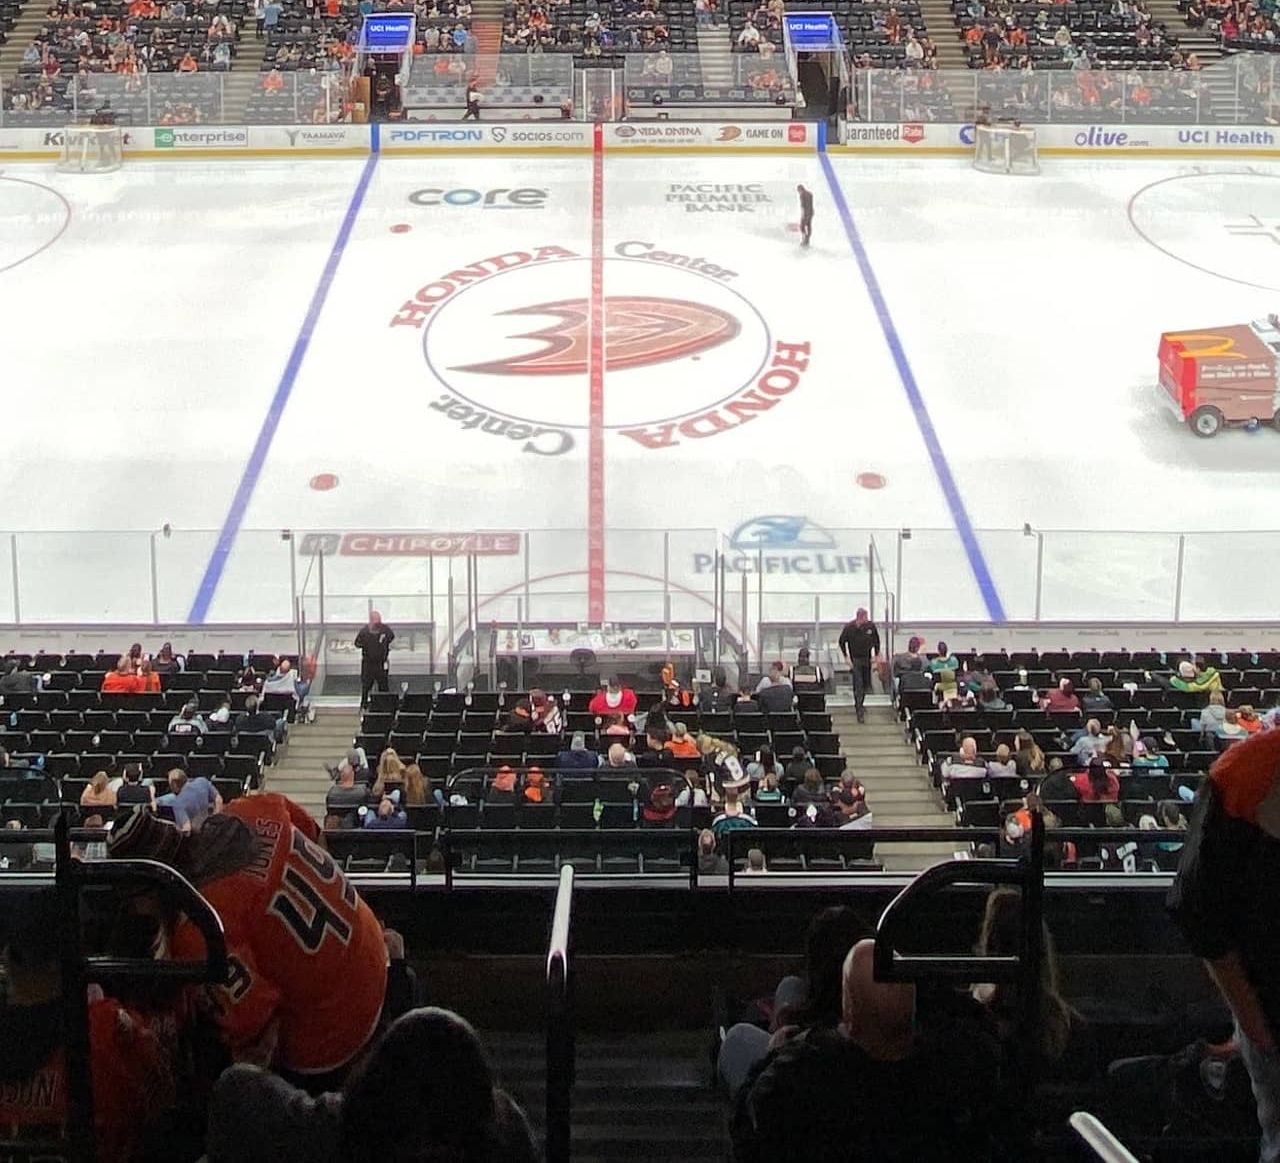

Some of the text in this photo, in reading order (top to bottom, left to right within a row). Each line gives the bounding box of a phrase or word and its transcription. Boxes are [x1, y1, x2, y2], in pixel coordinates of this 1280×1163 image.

[161, 132, 245, 144] enterprise
[390, 130, 482, 141] PDFTRON
[512, 132, 583, 141] socios.com
[746, 128, 769, 138] GAME
[771, 128, 783, 138] ON
[846, 126, 899, 140] uaranteed
[1179, 130, 1274, 144] UCI Health
[671, 183, 763, 194] PACIFIC
[408, 187, 546, 205] core
[666, 193, 772, 203] PREMIER
[685, 203, 755, 212] BANK
[390, 245, 580, 328] HONDA
[619, 341, 811, 449] HONDA
[349, 534, 513, 552] CHIPOTLE
[695, 553, 811, 574] PACIFIC
